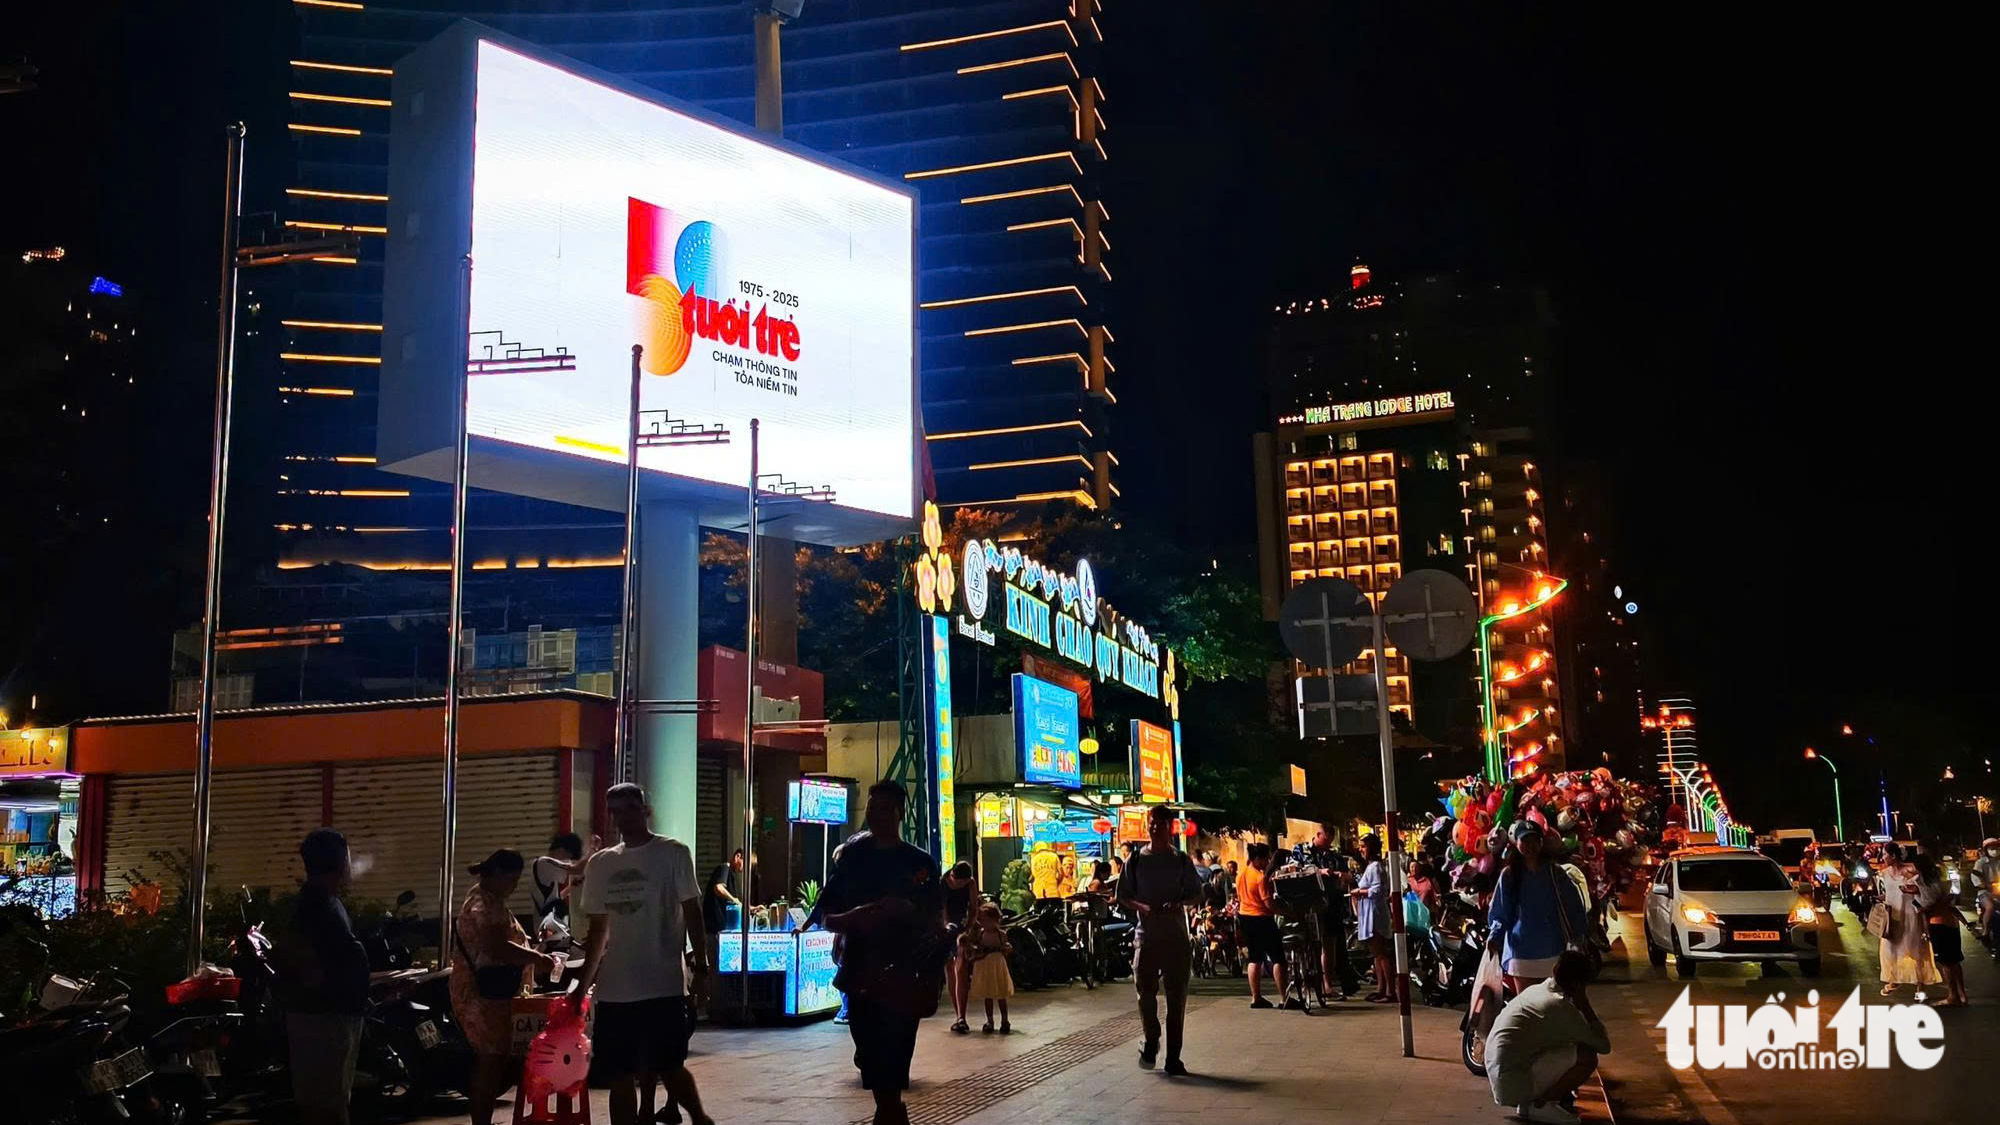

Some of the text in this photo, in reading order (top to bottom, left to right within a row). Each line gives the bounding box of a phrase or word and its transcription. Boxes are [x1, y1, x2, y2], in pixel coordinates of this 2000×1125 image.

[739, 279, 763, 298] 1975
[773, 290, 799, 308] 2025
[712, 350, 798, 381] CHẠM THÔNG TIN
[782, 383, 798, 396] TIN
[1305, 392, 1455, 424] NHA TRANG LODGE HOTEL
